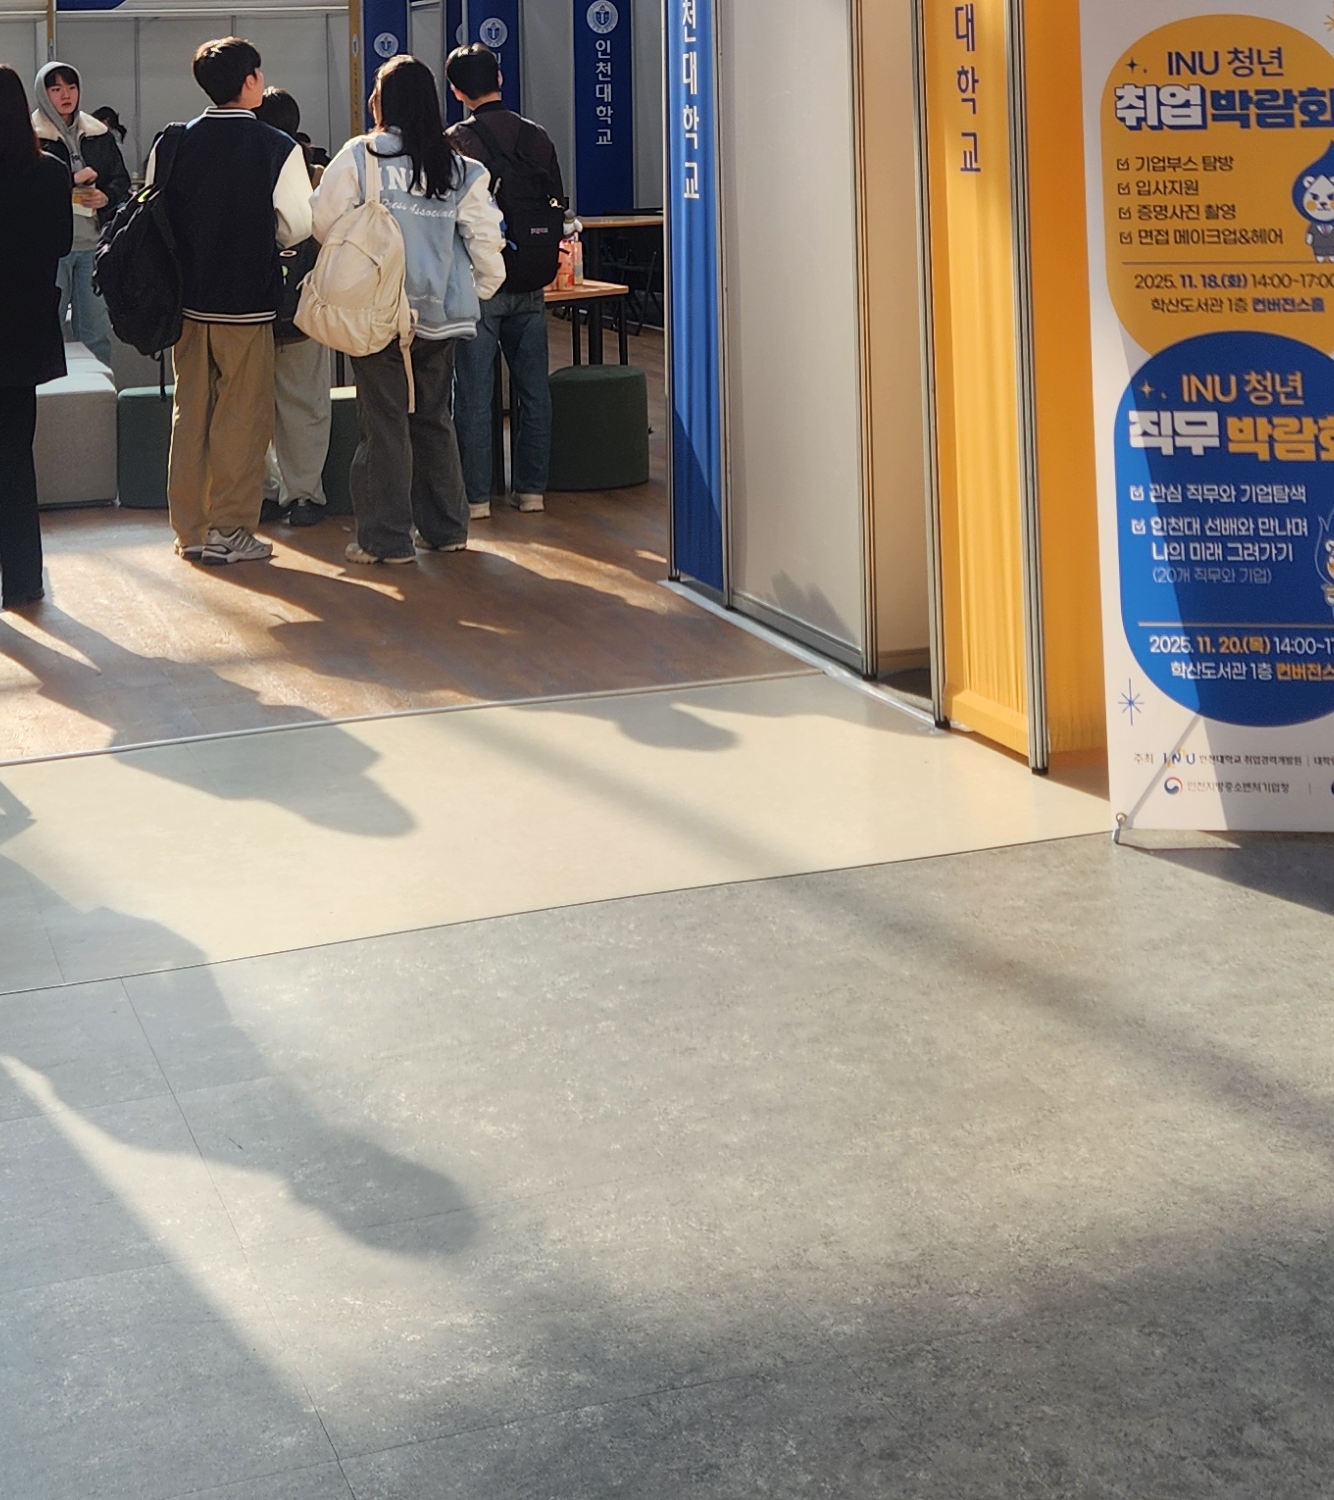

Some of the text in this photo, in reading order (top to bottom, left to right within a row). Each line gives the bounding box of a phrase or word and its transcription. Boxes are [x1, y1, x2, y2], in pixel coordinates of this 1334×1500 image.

[1167, 47, 1285, 77] INU 청년
[595, 39, 613, 146] 인천대학교
[1114, 84, 1208, 131] 취업
[1135, 155, 1235, 172] 기업부스 탐방
[1136, 180, 1199, 196] 입사지원
[1137, 204, 1237, 221] 증명사진 촬영
[1138, 228, 1284, 245] 면접 메이크업&헤어
[1134, 275, 1177, 290] 2025.
[1180, 275, 1198, 289] 11.
[1151, 297, 1224, 313] 학산도서관
[1227, 298, 1248, 313] 1층
[1181, 371, 1304, 404] INU 청년
[1129, 409, 1221, 456] 직무
[1150, 484, 1306, 503] 관심 직무와 기업탐색
[1151, 518, 1309, 537] 인천대 선배와 만나며
[1152, 542, 1293, 562] 나의 미래 그려가기
[1149, 636, 1195, 653] 2025.
[1197, 637, 1217, 652] 11.
[1171, 661, 1246, 680] 학산도서관
[1250, 663, 1273, 680] 1층
